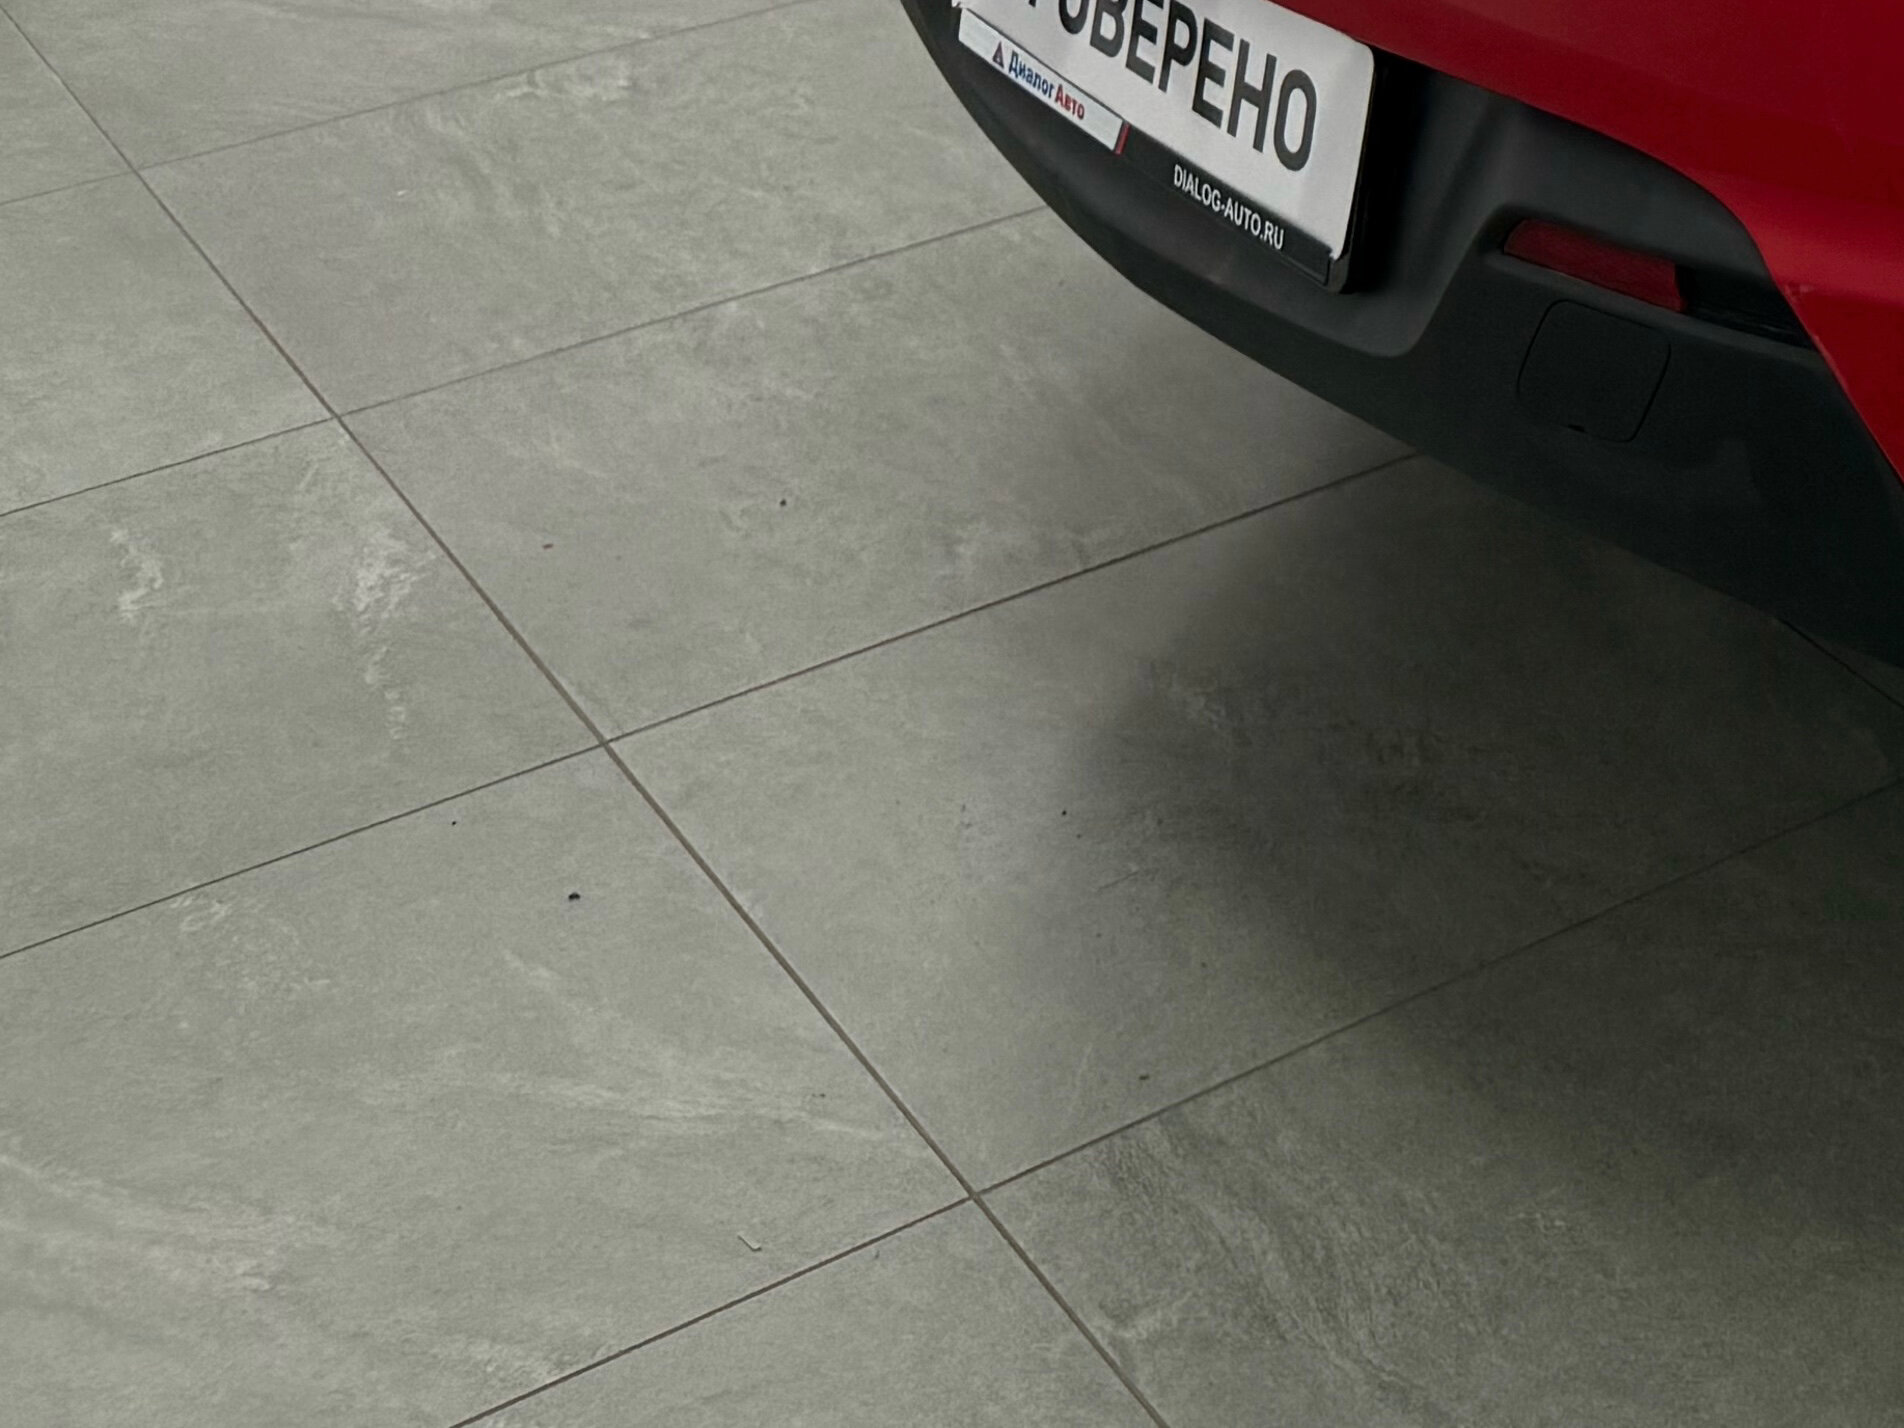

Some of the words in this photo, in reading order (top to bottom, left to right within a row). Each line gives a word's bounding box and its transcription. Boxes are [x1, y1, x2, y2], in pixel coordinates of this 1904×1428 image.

[1008, 50, 1054, 99] Диалог
[1055, 83, 1086, 121] Авто
[1173, 163, 1285, 250] DIALOG-AUTO.RU
